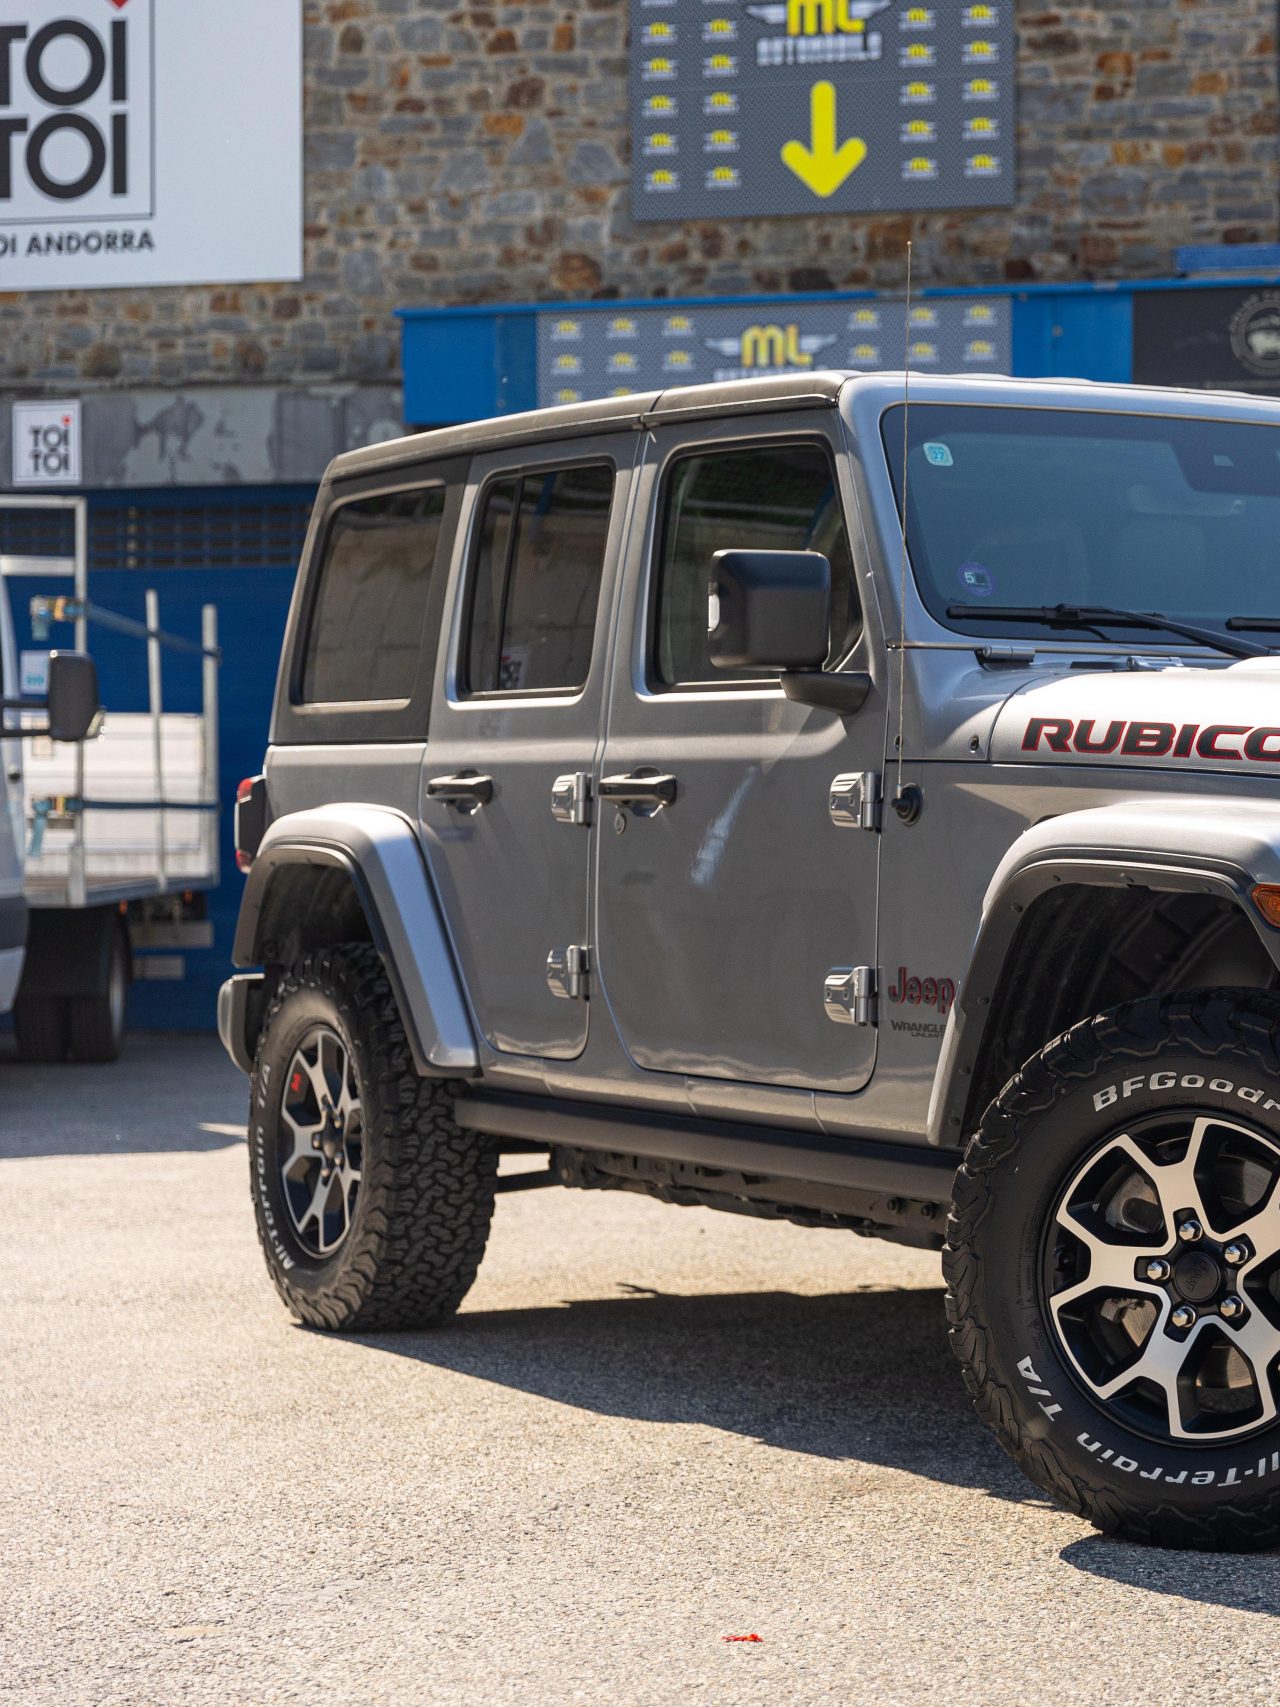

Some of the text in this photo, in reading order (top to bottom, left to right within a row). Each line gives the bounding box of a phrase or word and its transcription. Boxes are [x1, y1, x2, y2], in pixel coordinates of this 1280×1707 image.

[26, 229, 155, 256] ANDORRA
[742, 323, 812, 368] ML
[29, 425, 70, 449] TOI
[29, 449, 70, 474] TOI
[888, 966, 955, 1015] Jeep
[891, 1020, 947, 1034] WRANGLE
[1016, 1355, 1063, 1422] T/A
